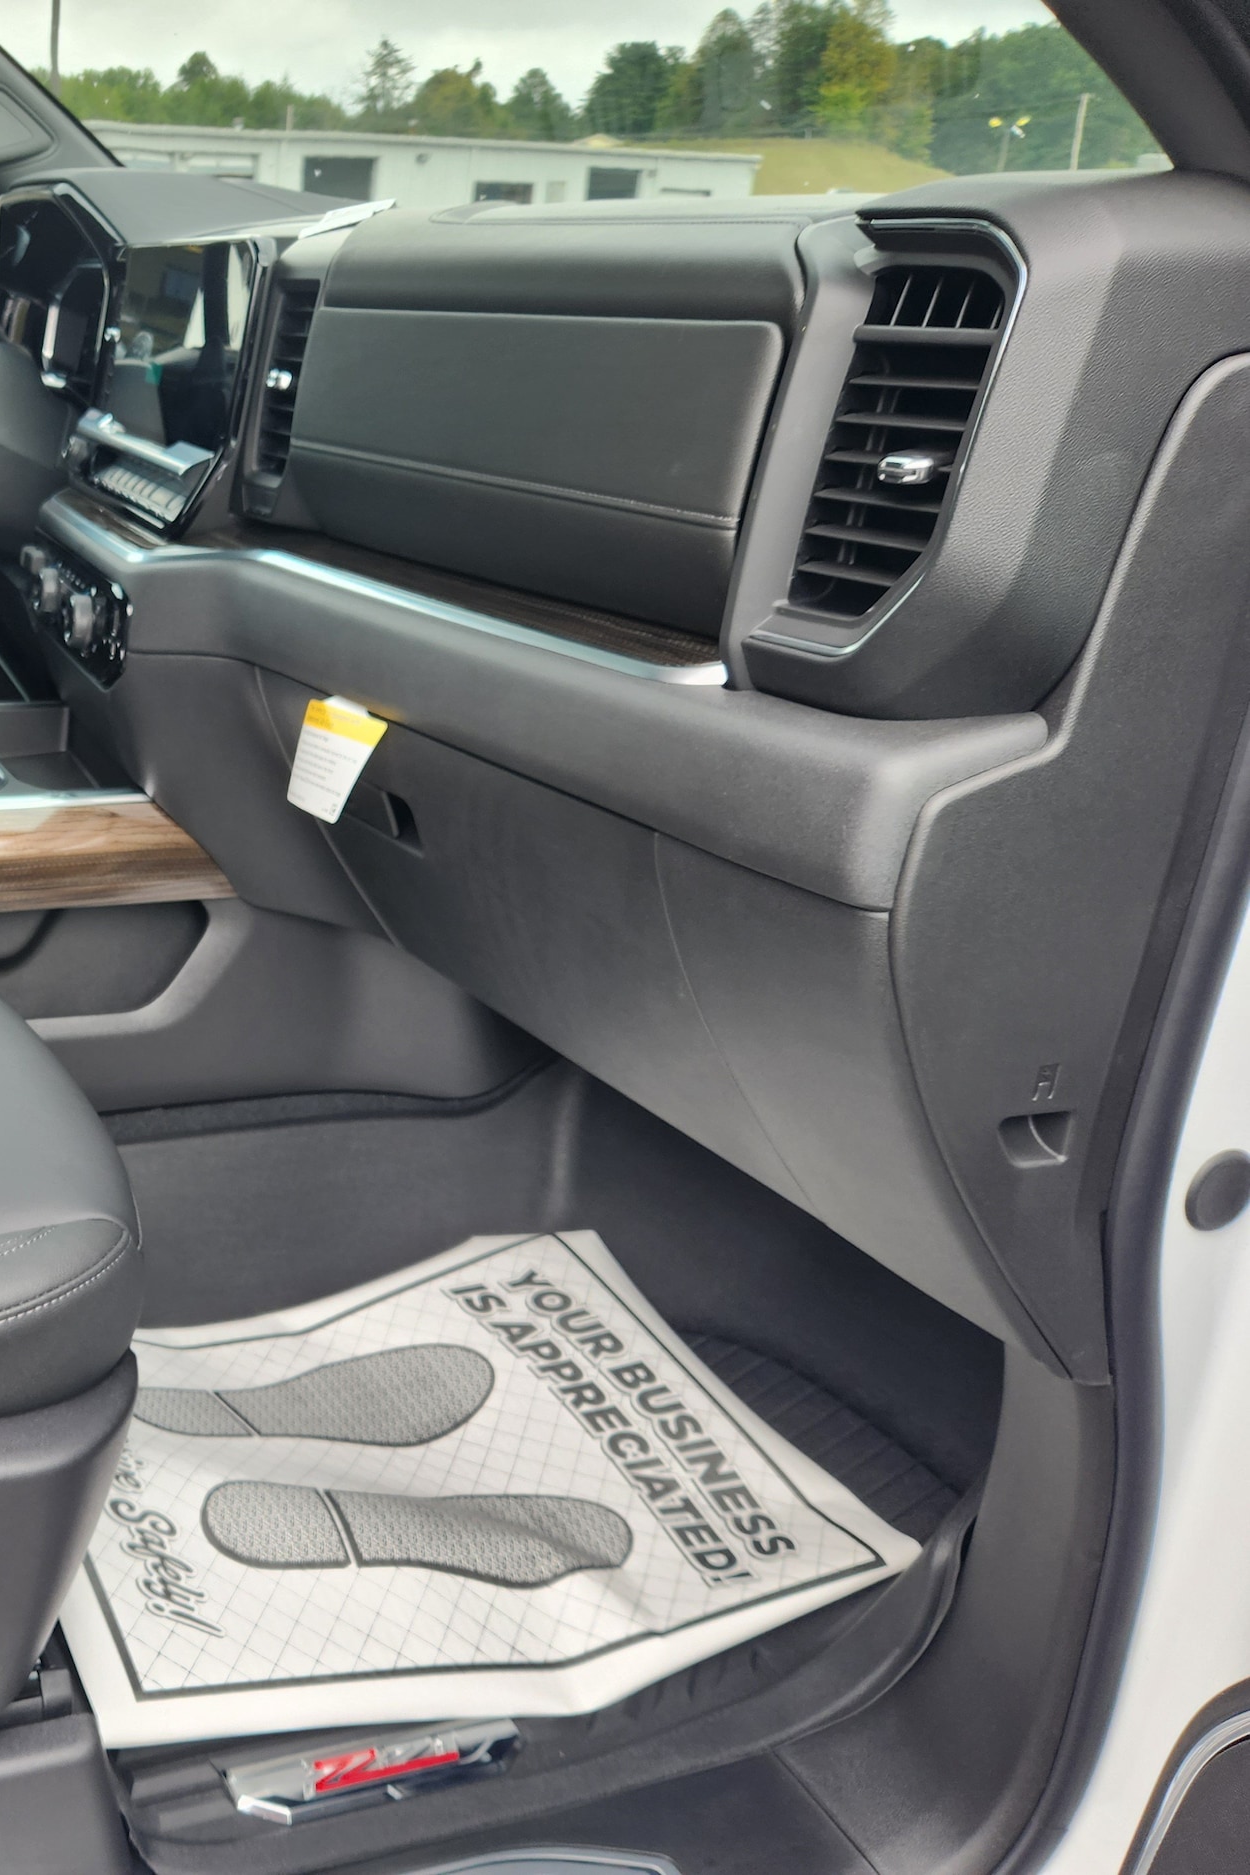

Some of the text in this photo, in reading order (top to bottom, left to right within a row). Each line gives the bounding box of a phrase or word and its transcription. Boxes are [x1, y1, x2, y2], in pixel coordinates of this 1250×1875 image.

[448, 1283, 751, 1584] IS APPRECIATED!
[508, 1269, 796, 1557] YOUR BUSINESS
[107, 1498, 224, 1635] Safely!
